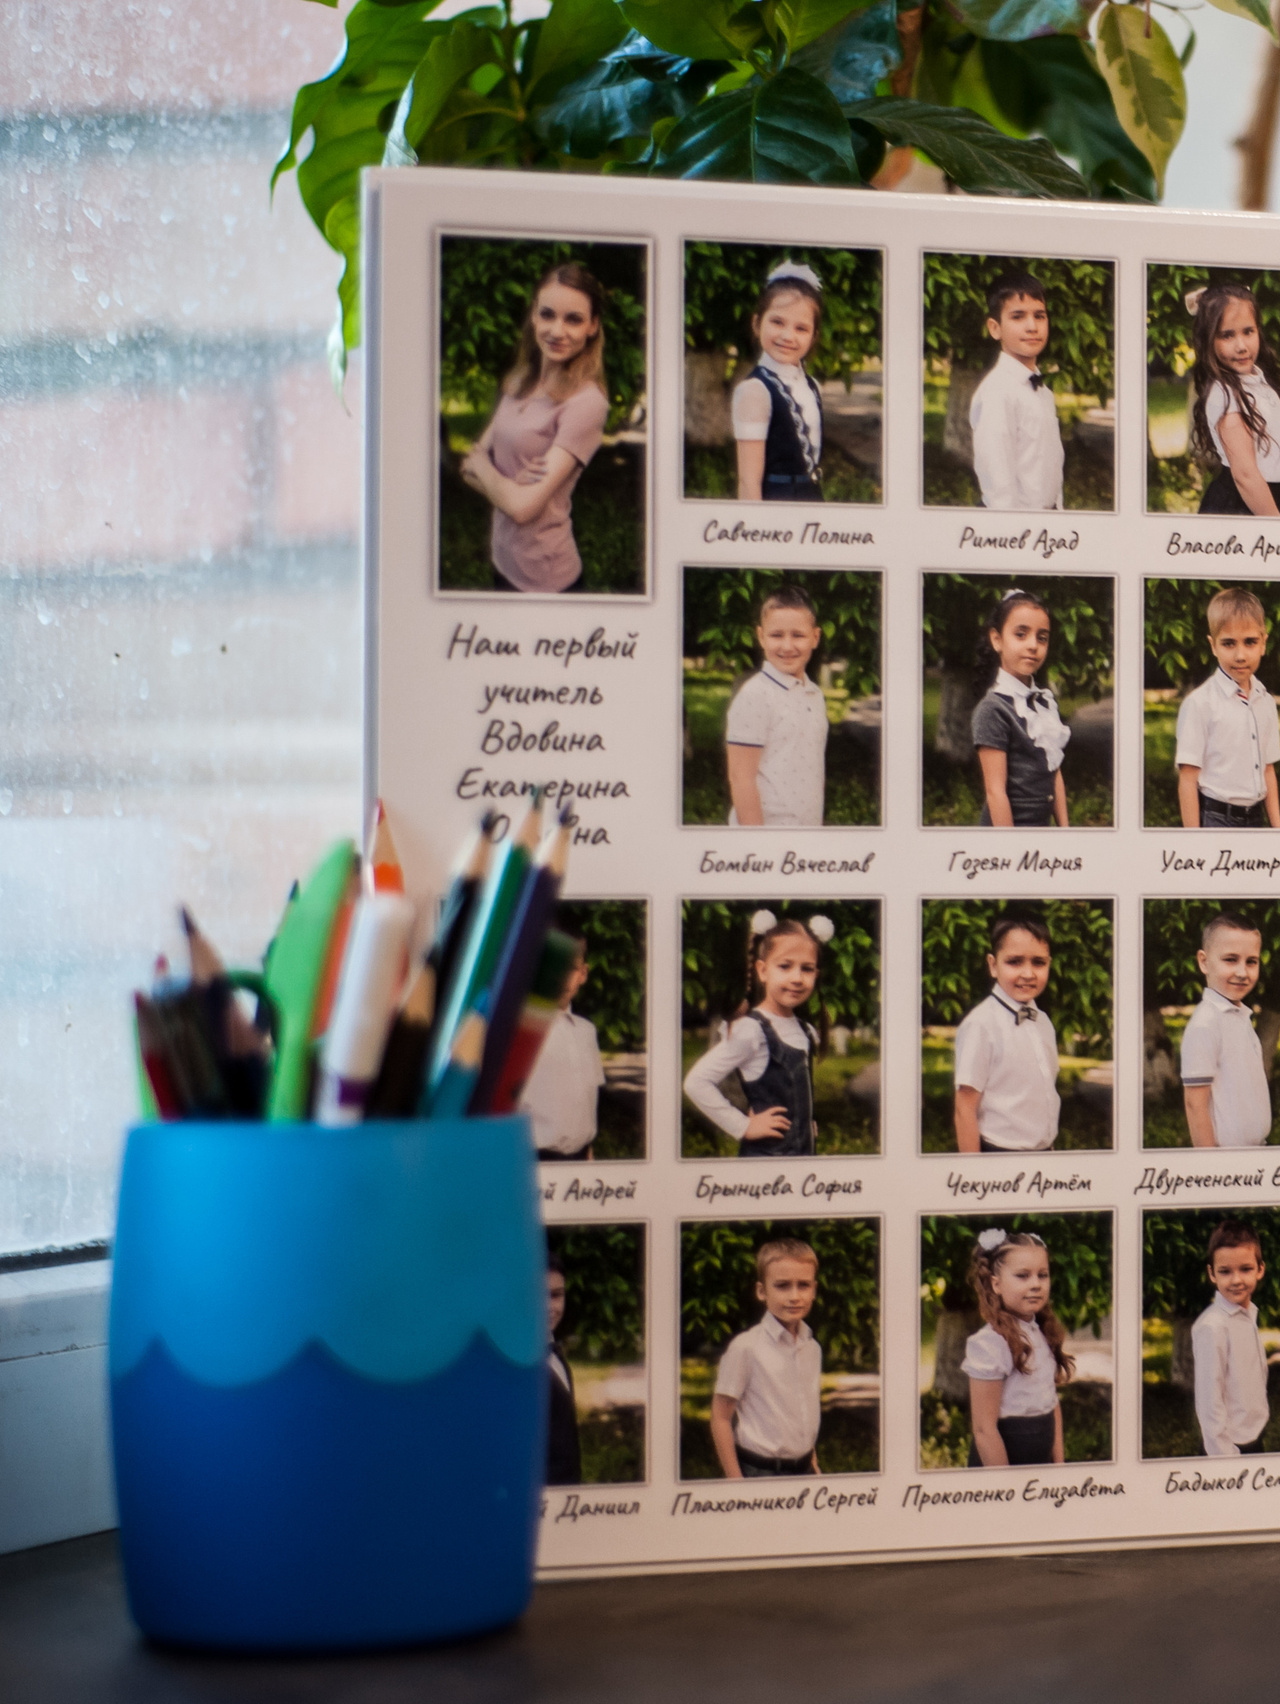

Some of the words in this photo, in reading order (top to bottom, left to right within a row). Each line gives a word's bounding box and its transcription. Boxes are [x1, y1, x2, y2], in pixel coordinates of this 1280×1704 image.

[703, 519, 793, 546] Савченко
[799, 520, 876, 546] Полина
[958, 526, 1031, 551] Римиев
[1032, 528, 1082, 558] Азад
[1166, 532, 1246, 557] Власова
[447, 622, 521, 660] Наш
[533, 626, 640, 669] первый
[477, 683, 604, 714] учитель
[480, 718, 606, 756] Вдовина
[699, 851, 773, 873] Бомбин
[780, 850, 877, 875] Вячеслав
[948, 850, 1012, 880] Гозеян
[1016, 850, 1082, 875] Мария
[1160, 850, 1206, 873] Усач
[562, 1178, 637, 1207] Андрей
[695, 1174, 794, 1204] Брынцева
[801, 1173, 863, 1203] София
[946, 1172, 1024, 1200] Чекунов
[1026, 1171, 1092, 1198] Артём
[1133, 1167, 1265, 1199] Двуреченский
[902, 1484, 1016, 1513] Прокопенко
[1022, 1478, 1126, 1508] Елизавета
[1165, 1469, 1245, 1495] Бадыков
[554, 1494, 641, 1523] Даниил
[671, 1488, 806, 1515] Плахотников
[813, 1486, 879, 1515] Сергей
